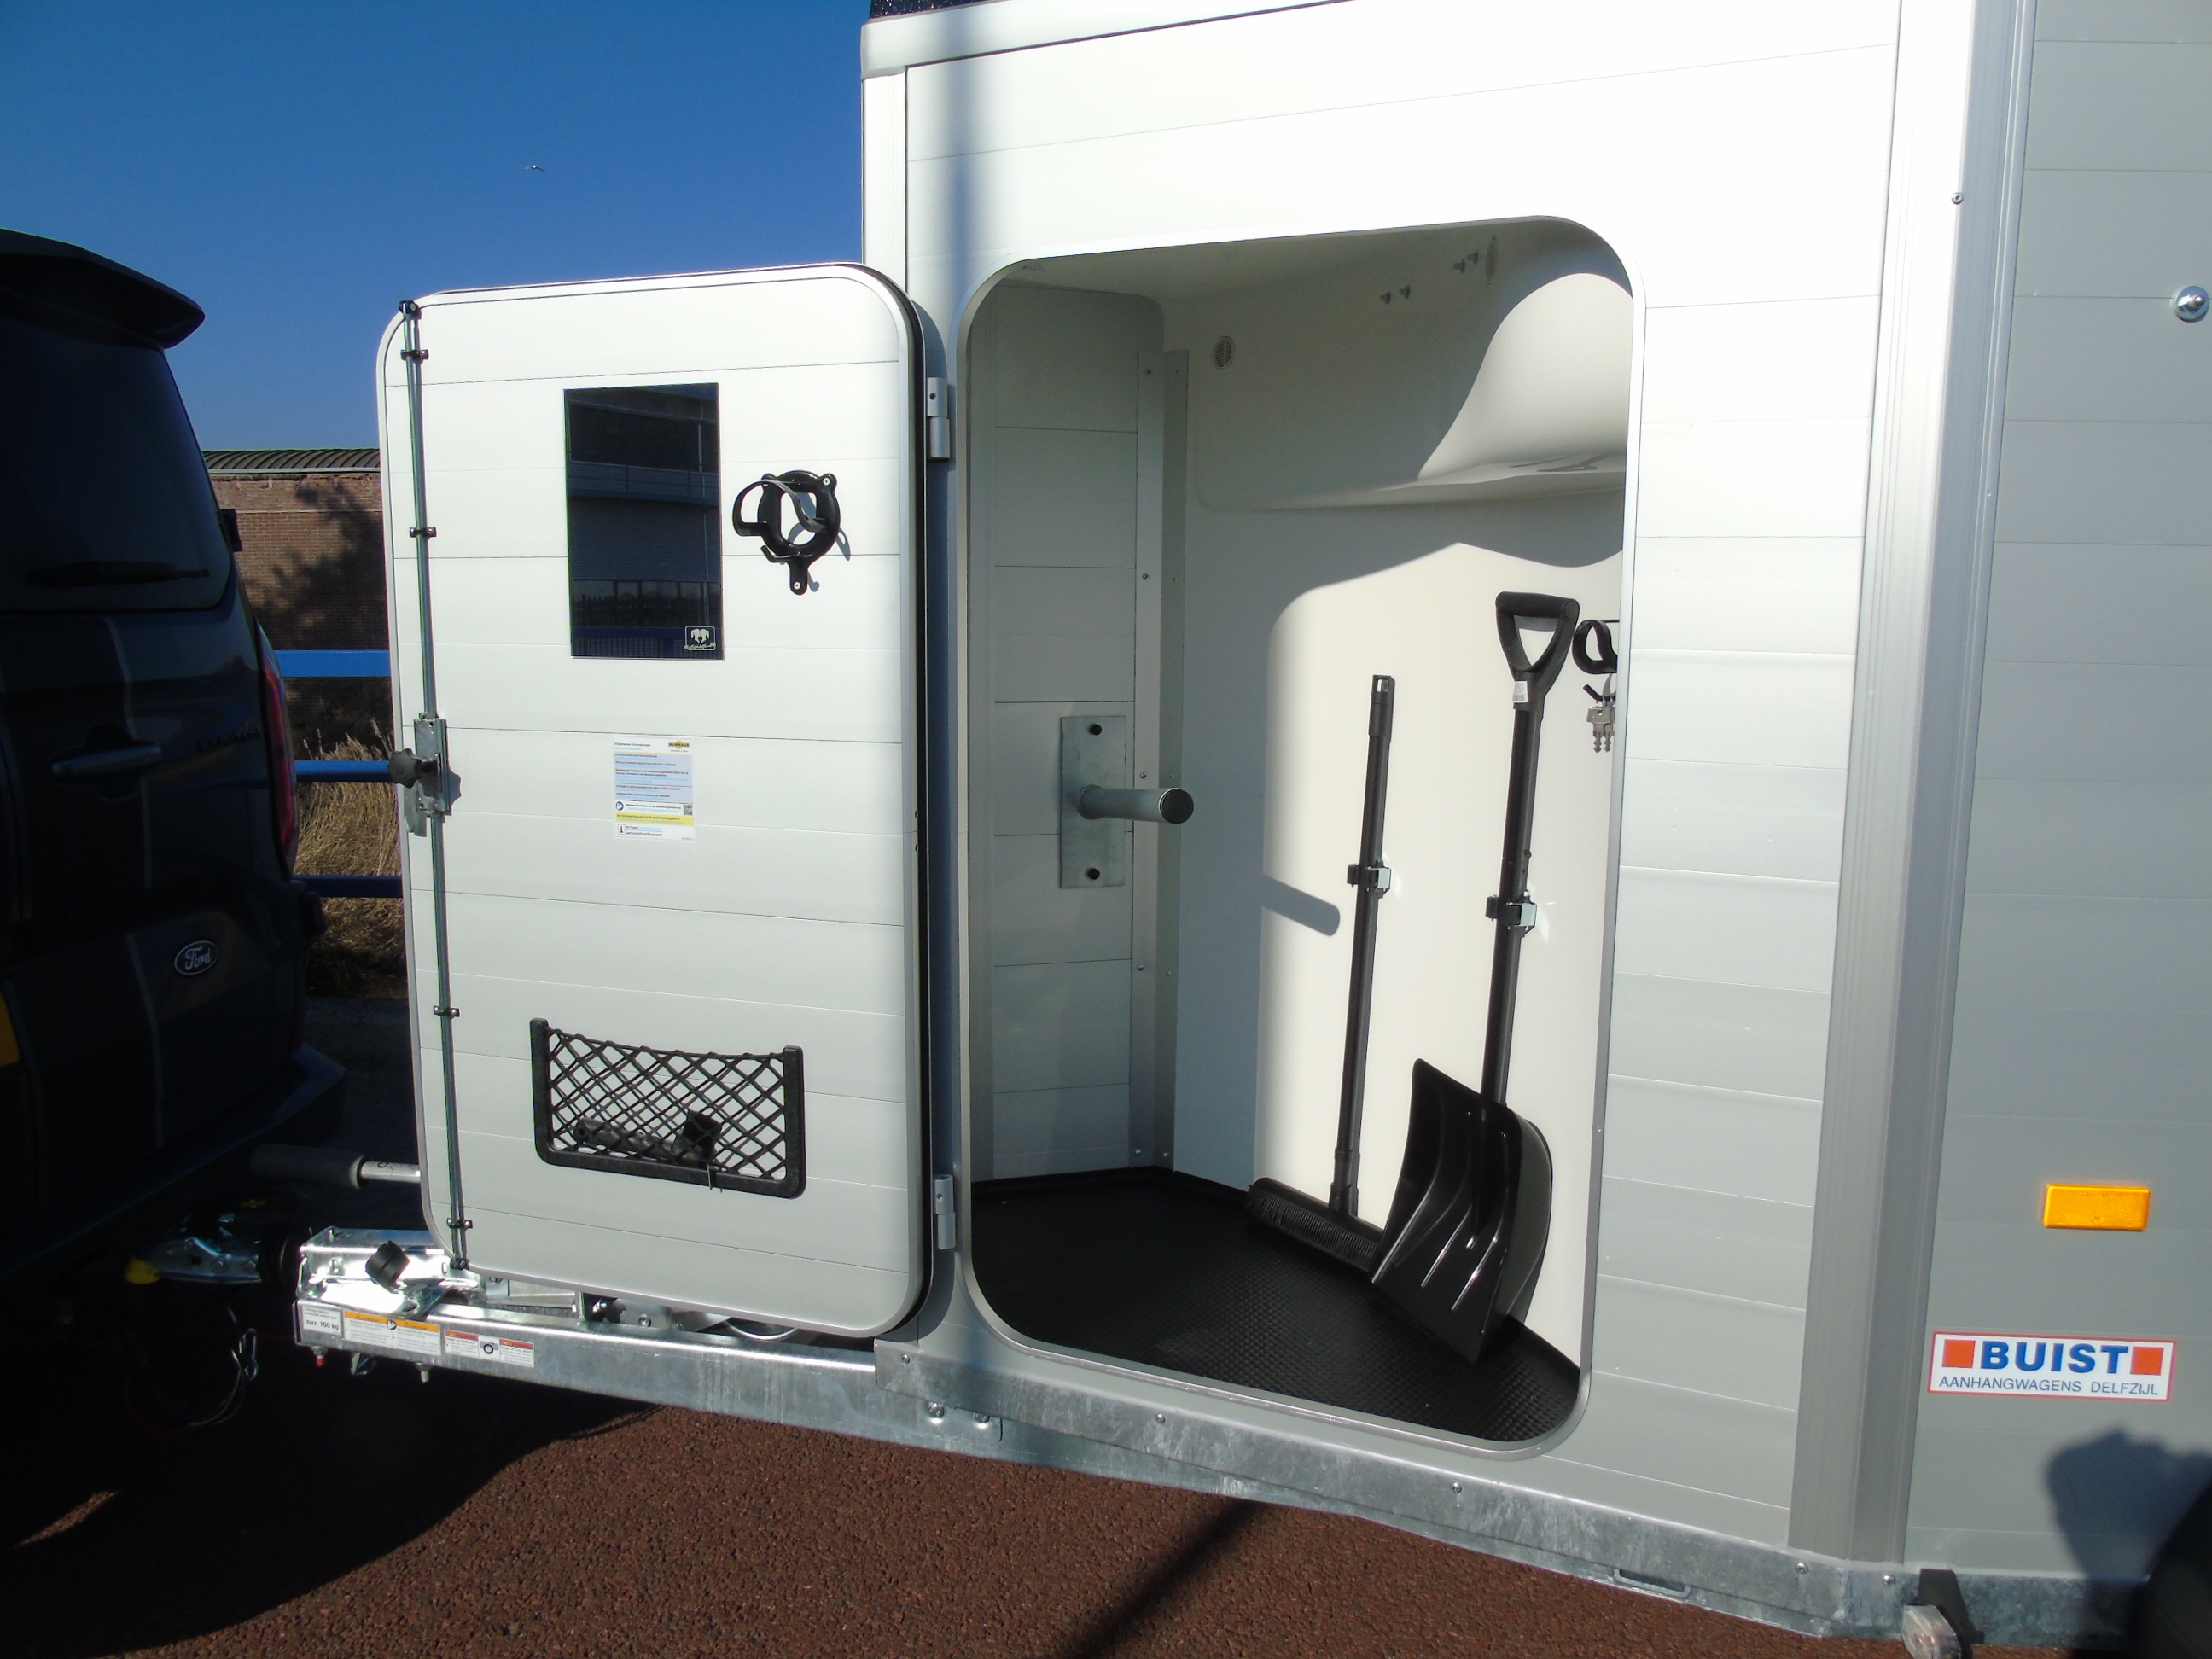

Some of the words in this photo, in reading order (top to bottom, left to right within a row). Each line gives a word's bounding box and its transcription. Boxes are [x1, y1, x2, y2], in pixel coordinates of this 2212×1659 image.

[184, 946, 212, 971] Ford
[305, 1318, 319, 1327] max.
[320, 1320, 330, 1329] 100
[331, 1321, 339, 1331] kg
[1980, 1340, 2129, 1375] BUIST
[1939, 1376, 2081, 1393] AANHANGWAGENS
[2090, 1381, 2159, 1395] DELFZIJL
